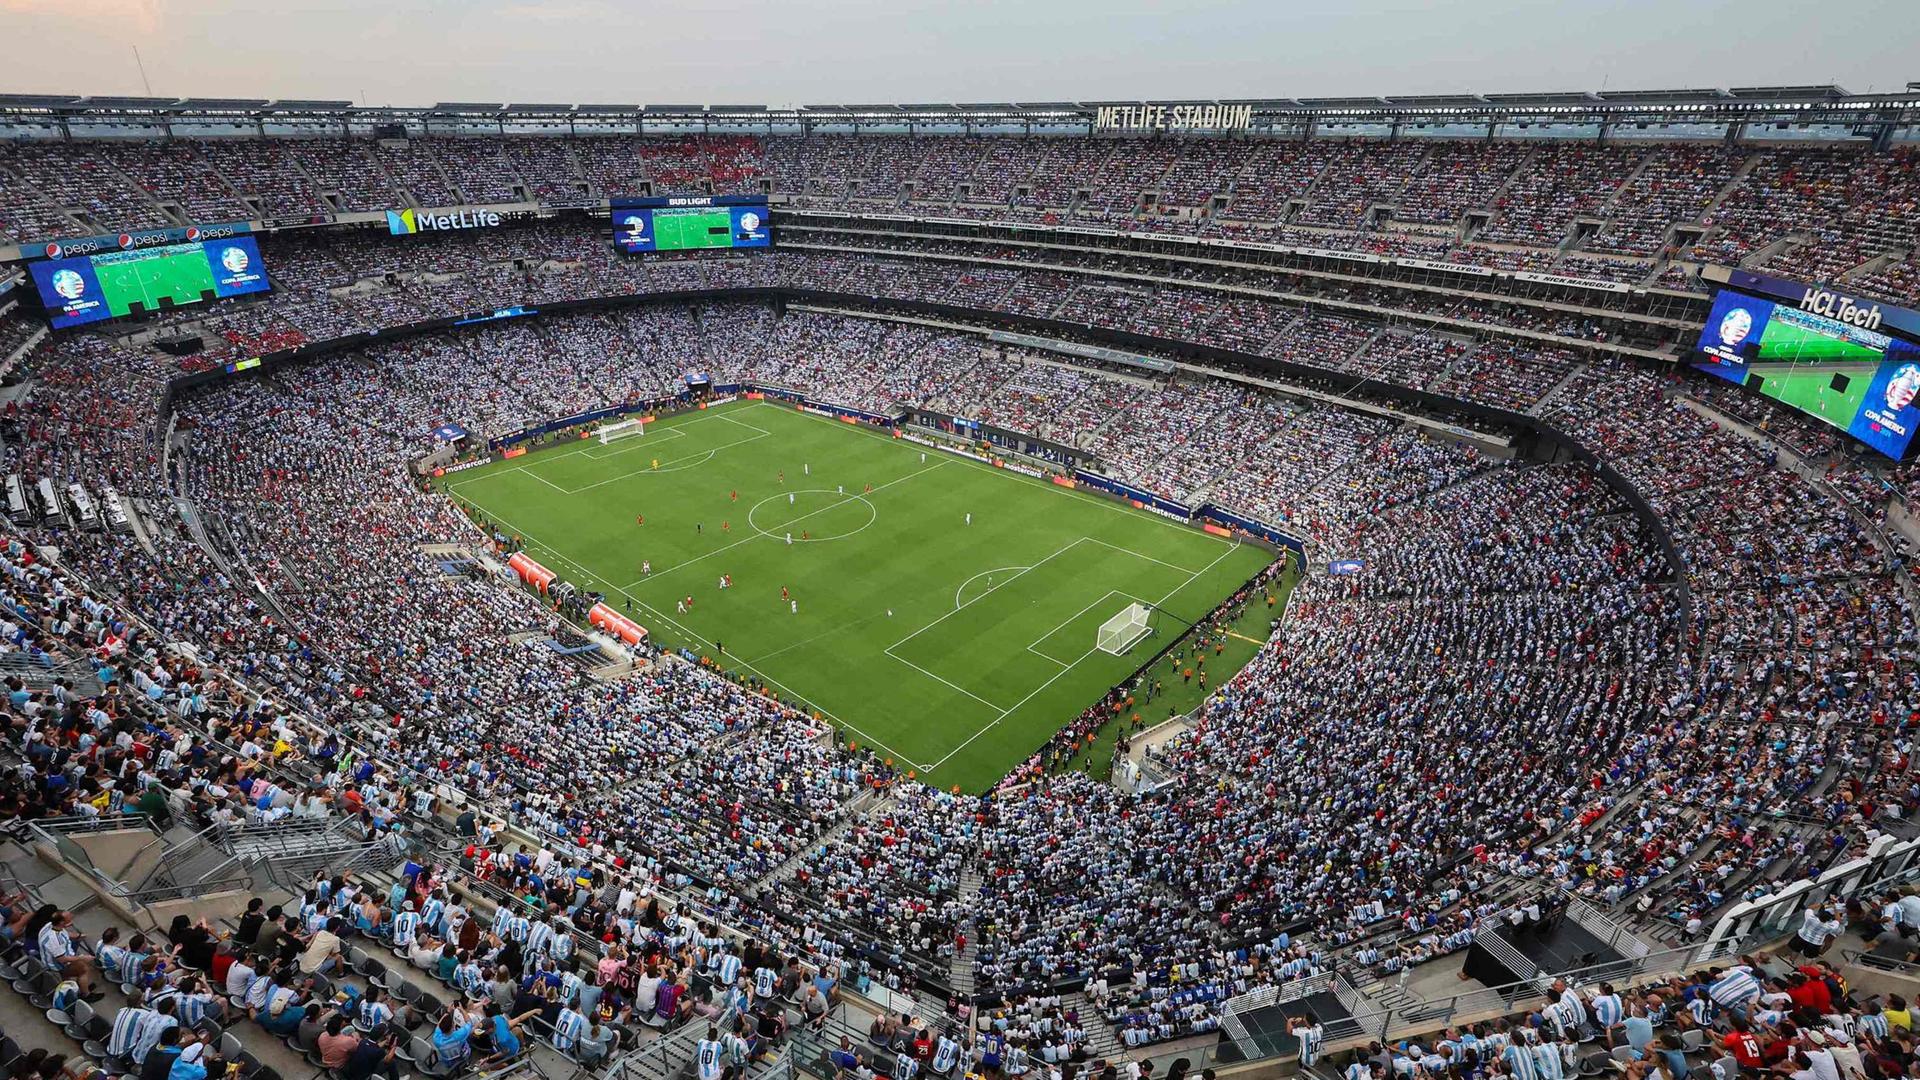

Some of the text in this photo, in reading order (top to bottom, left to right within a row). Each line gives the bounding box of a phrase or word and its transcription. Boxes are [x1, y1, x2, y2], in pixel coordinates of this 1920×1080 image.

[1097, 104, 1252, 129] METLIFE STADIUM
[687, 197, 712, 205] LIGHT
[416, 208, 500, 231] MetLife
[134, 232, 169, 248] pepsi
[201, 225, 234, 240] pepsi
[63, 240, 99, 257] pepsi
[1426, 262, 1456, 270] MARTY
[222, 277, 237, 285] COPA
[1543, 276, 1566, 284] NICK
[1566, 279, 1616, 289] MANGOLD
[1800, 287, 1883, 330] HCLTech
[1704, 346, 1719, 356] COPA
[1864, 410, 1881, 422] COPA
[902, 433, 934, 448] mastercard
[445, 457, 491, 474] mastercard
[1004, 462, 1042, 478] mastercard
[1144, 504, 1190, 524] mastercard
[397, 919, 409, 933] 10
[759, 976, 768, 988] 10
[1843, 1022, 1855, 1038] 10
[939, 1046, 950, 1057] 10
[987, 1040, 998, 1055] 10
[1744, 1039, 1760, 1058] 19
[701, 1048, 713, 1065] 10
